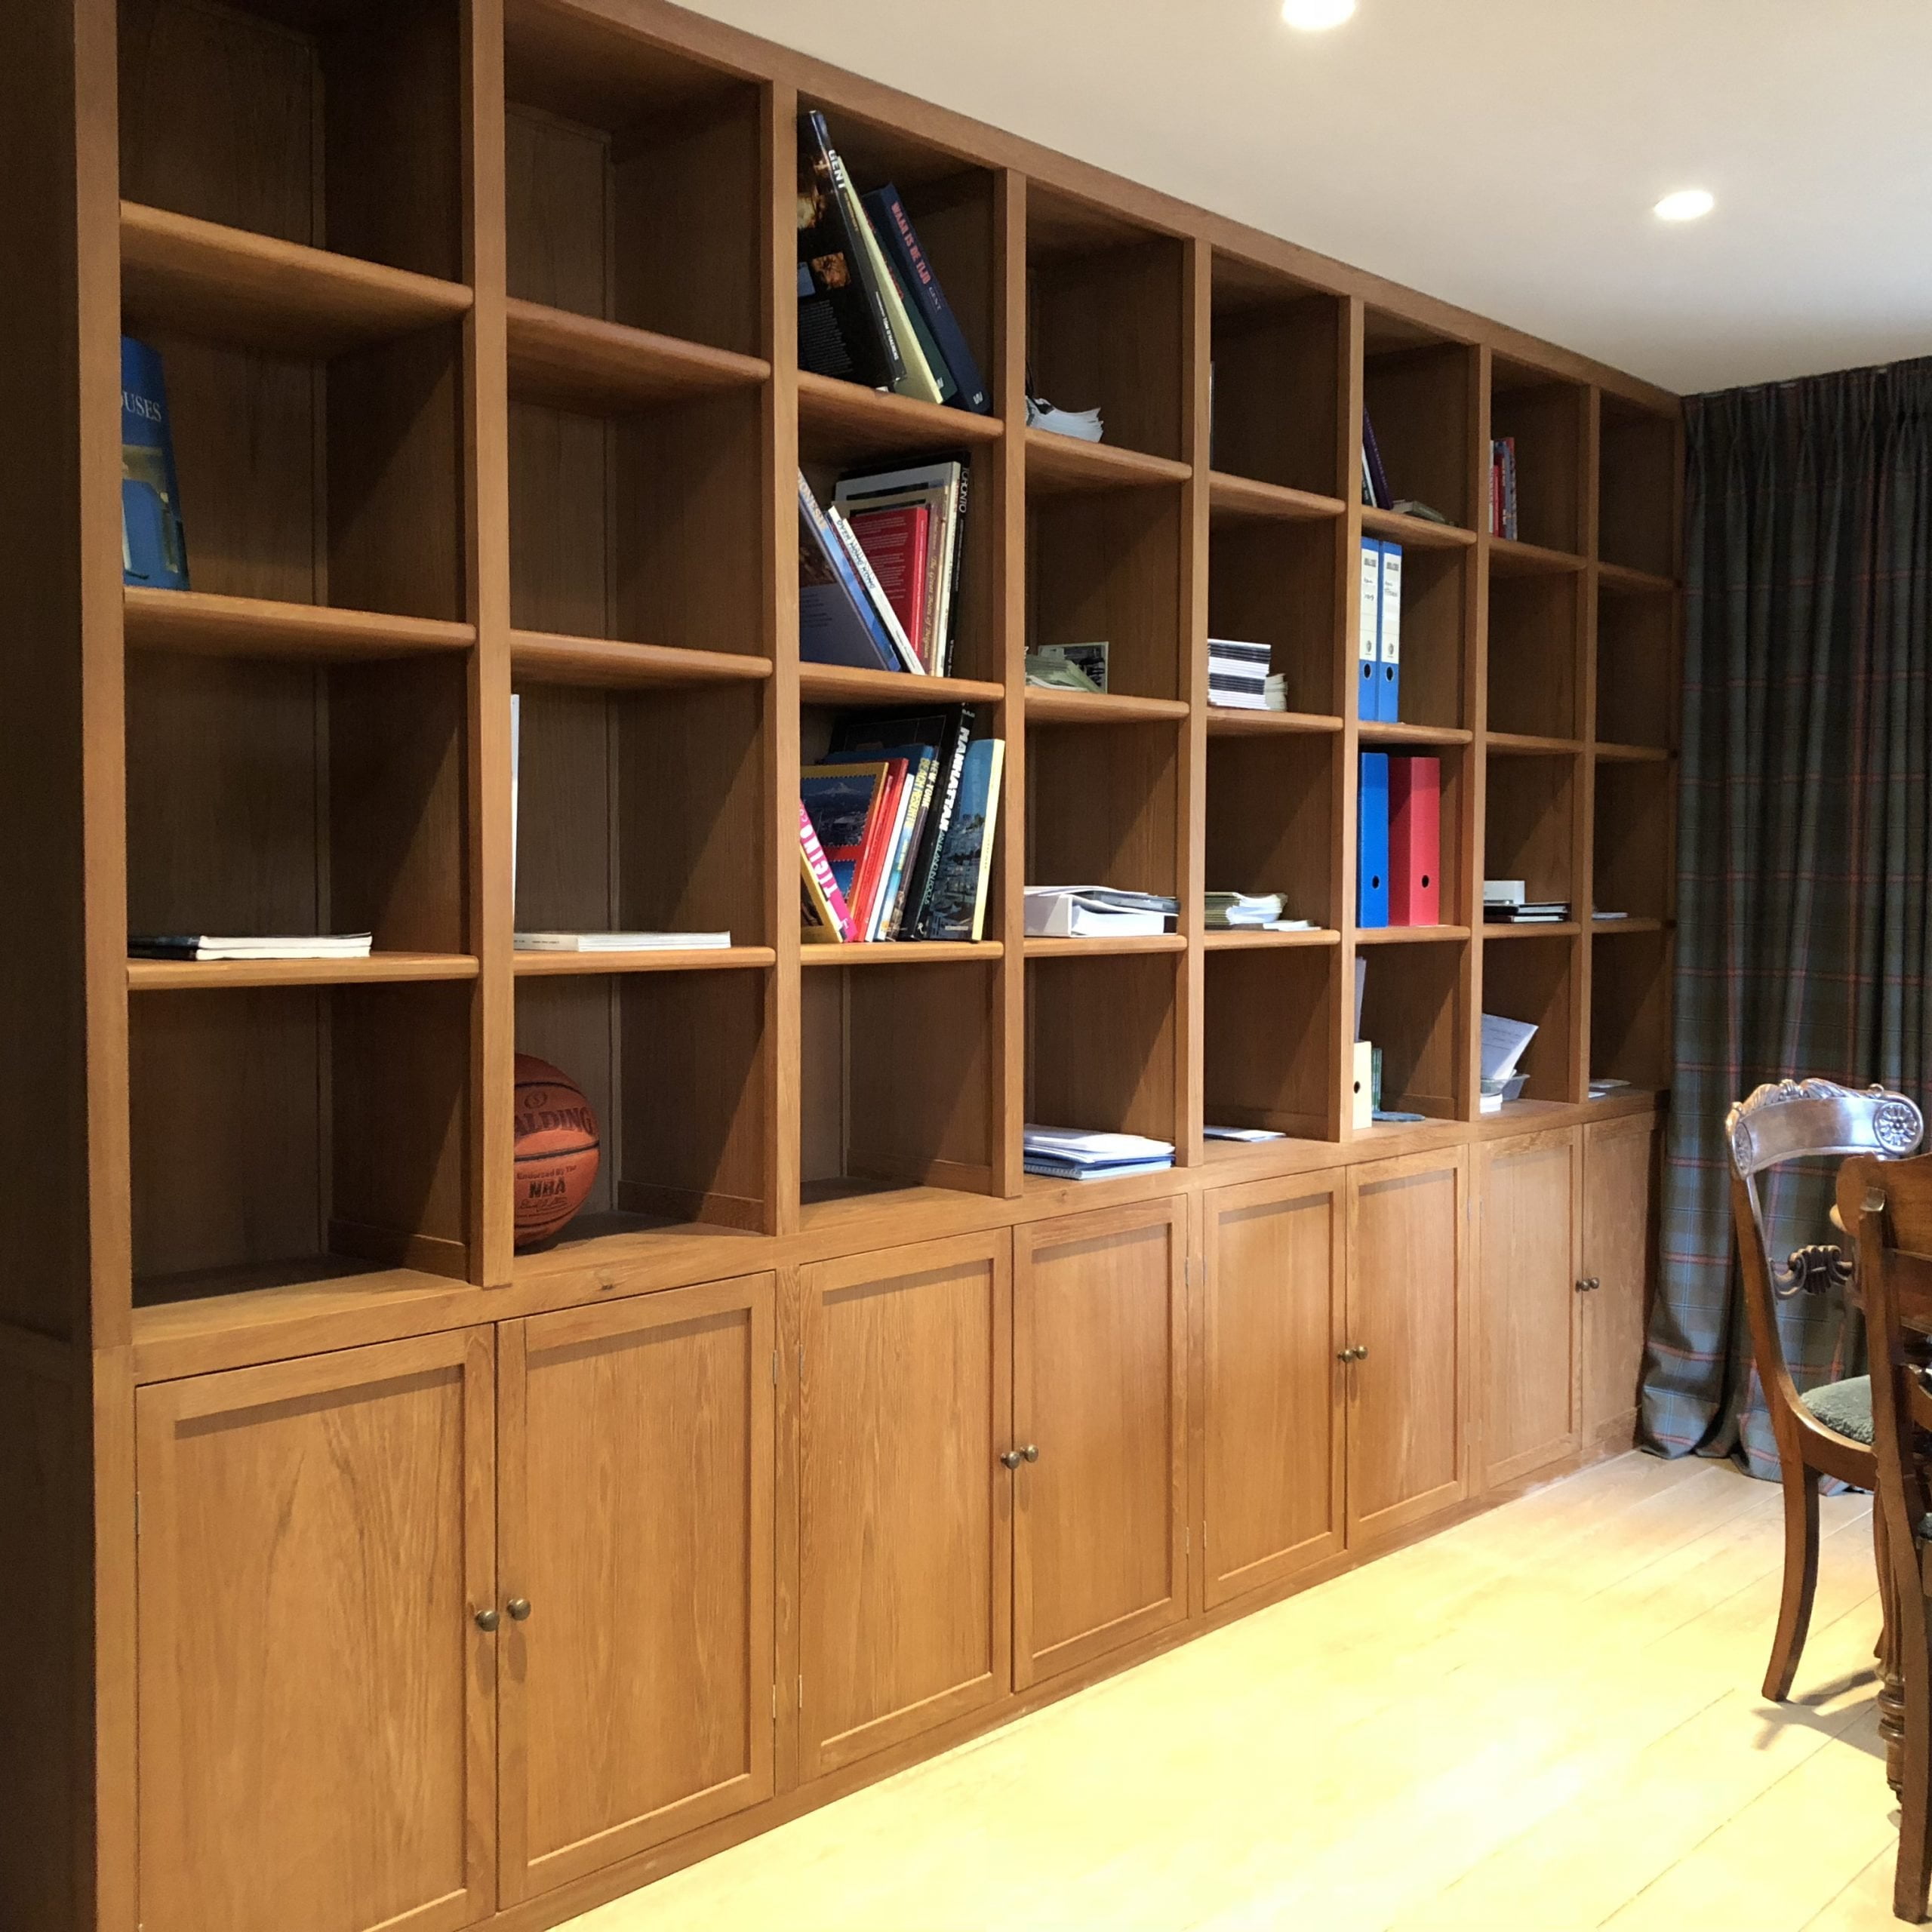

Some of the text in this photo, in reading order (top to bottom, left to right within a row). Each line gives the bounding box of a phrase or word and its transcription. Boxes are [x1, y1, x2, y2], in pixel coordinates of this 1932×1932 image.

[829, 149, 845, 189] GENT
[929, 287, 941, 310] GENT
[122, 391, 162, 423] USES
[959, 467, 969, 513] TORONTO
[836, 520, 875, 589] OVER HONG KONG
[915, 758, 931, 789] BEACH
[921, 760, 940, 808] NEW YORK
[940, 727, 970, 832] MANHATTAN
[800, 824, 838, 898] TICINO
[530, 1177, 565, 1198] NBA
